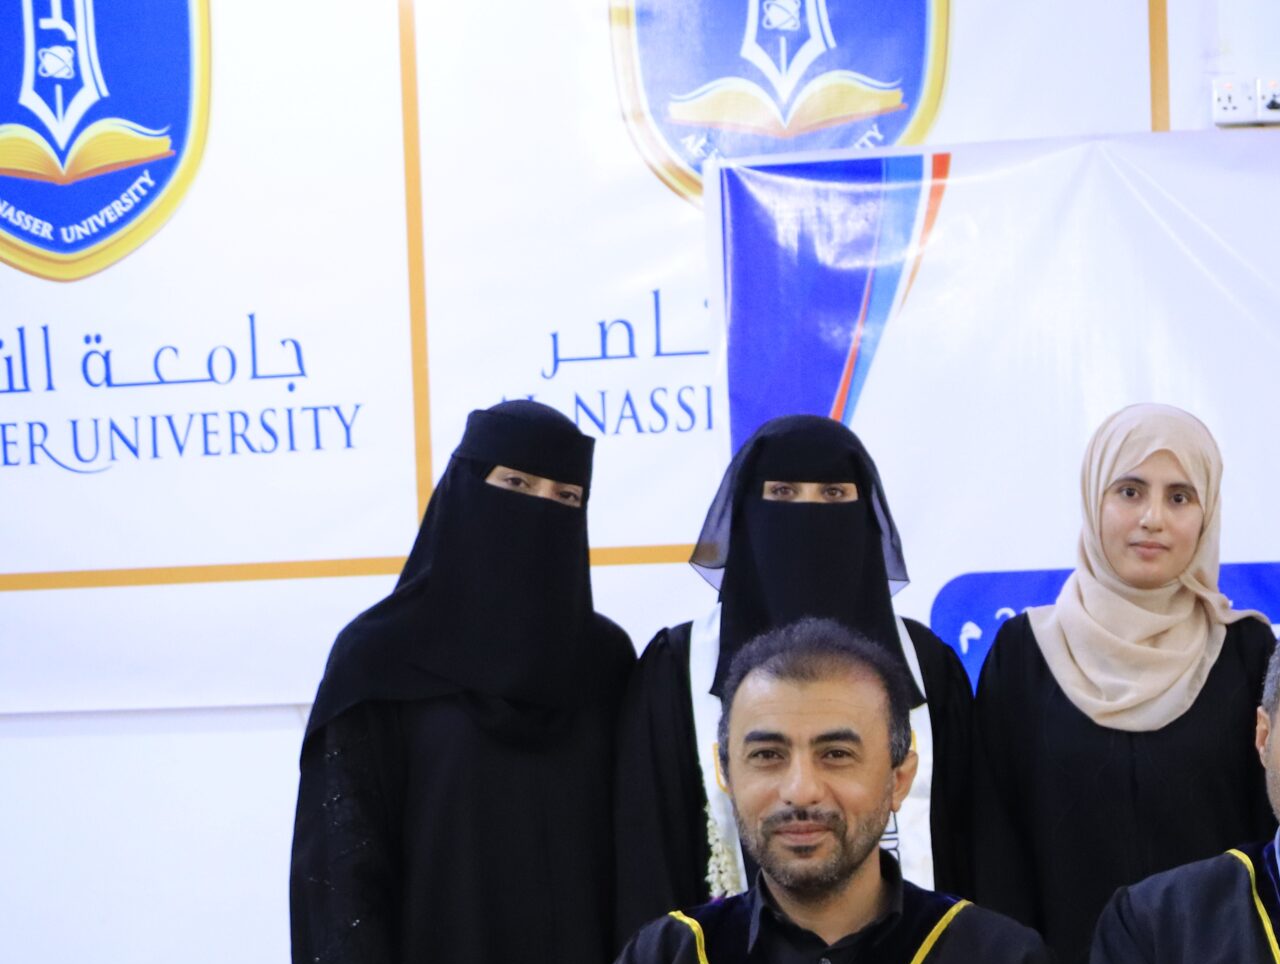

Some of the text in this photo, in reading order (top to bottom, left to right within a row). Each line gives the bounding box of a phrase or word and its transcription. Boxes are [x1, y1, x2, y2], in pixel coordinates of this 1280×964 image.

[60, 169, 156, 244] UNIVERSITY
[81, 311, 308, 394] جامعة
[541, 288, 711, 380] اصر
[67, 403, 363, 464] UNIVERSITY
